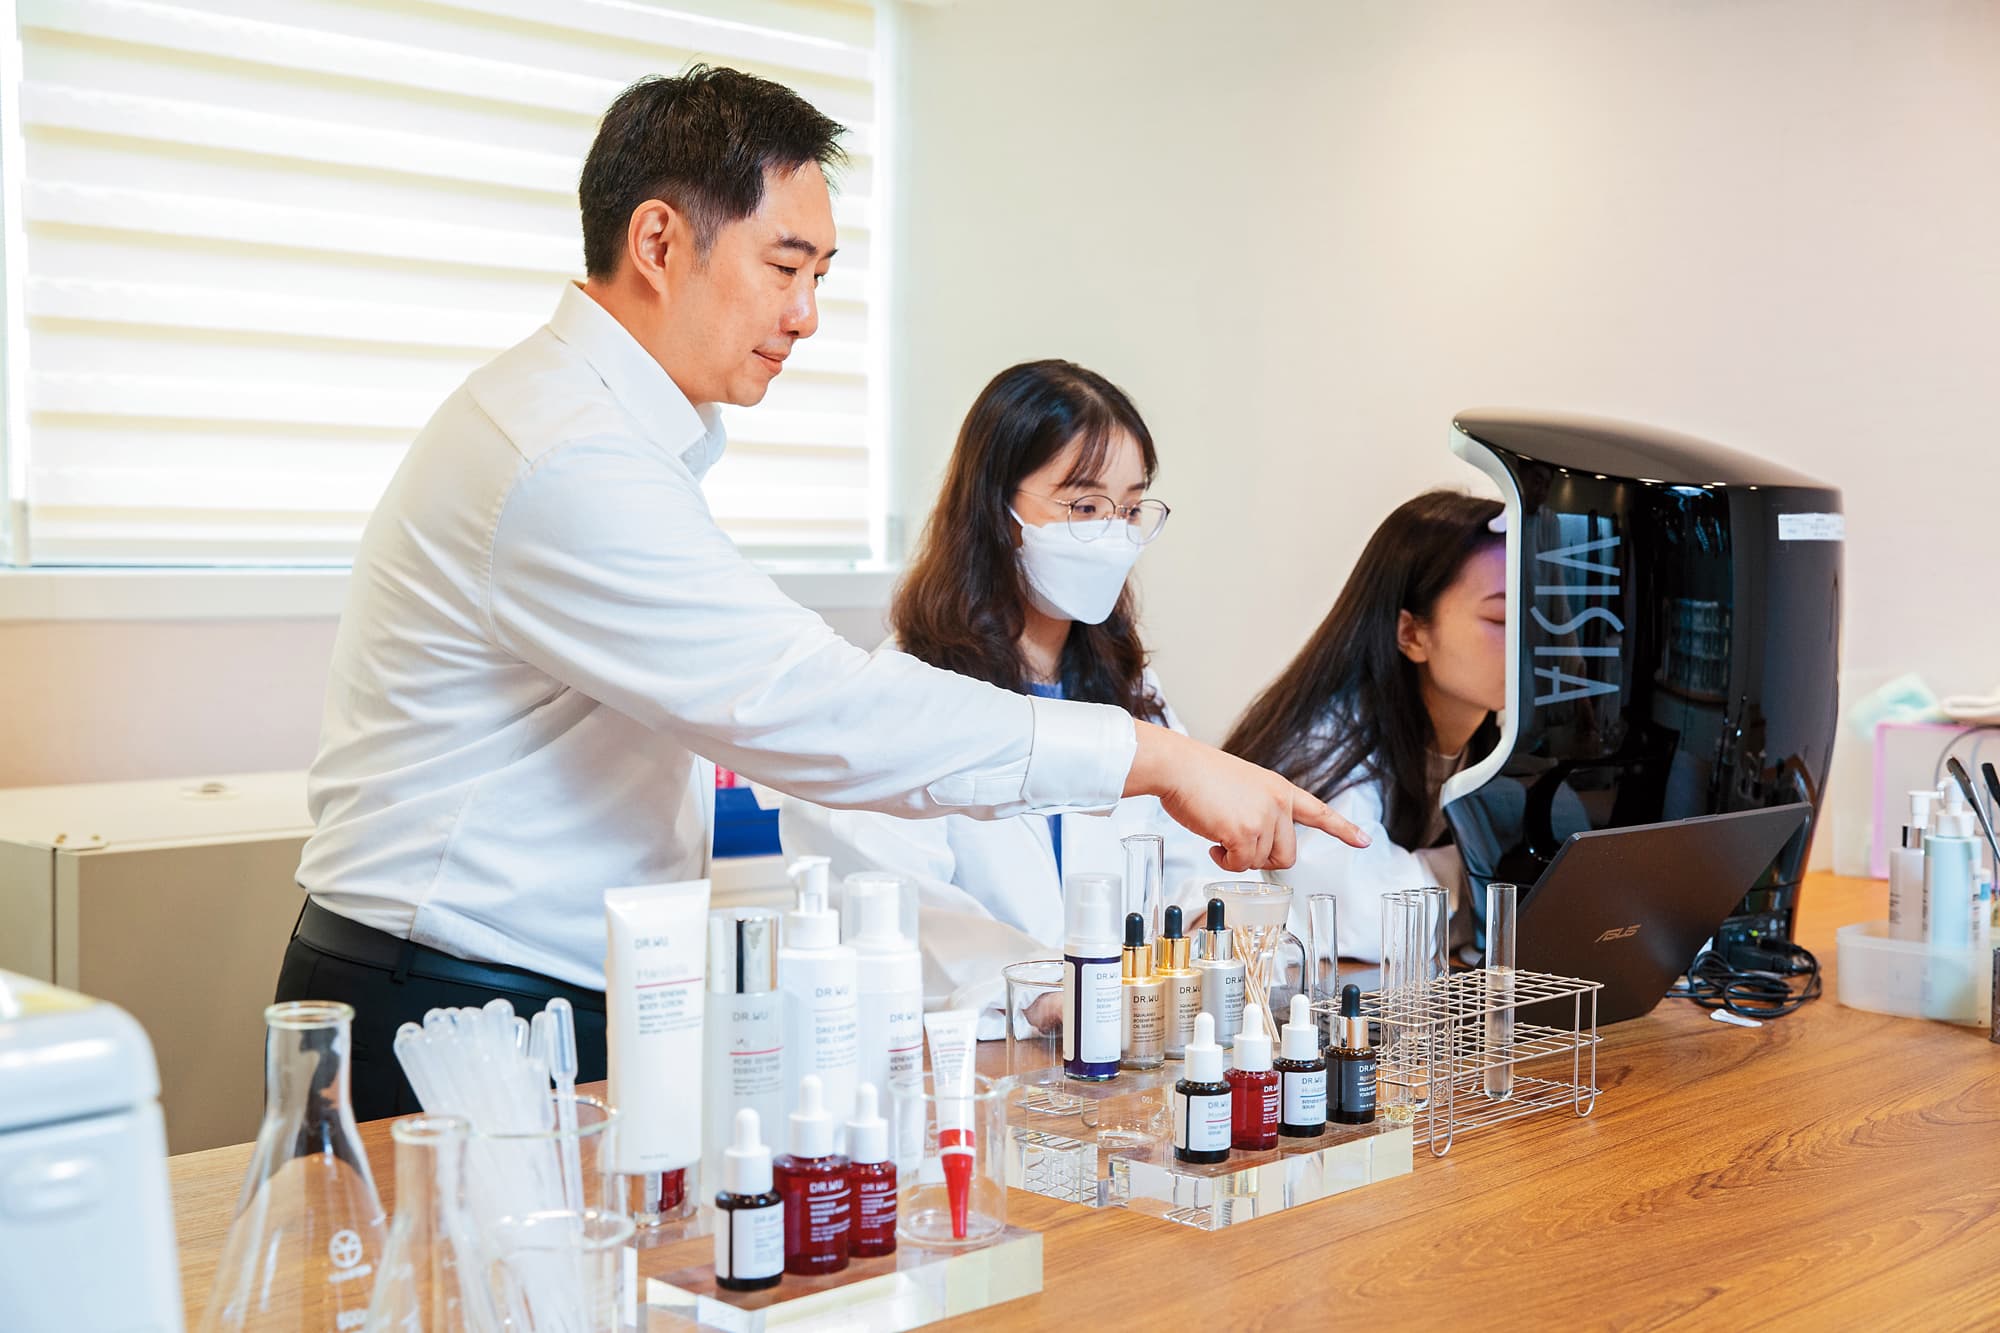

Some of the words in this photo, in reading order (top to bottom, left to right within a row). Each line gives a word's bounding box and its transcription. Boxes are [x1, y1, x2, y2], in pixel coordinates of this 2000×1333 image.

[1530, 536, 1624, 705] VISIA
[1594, 923, 1642, 943] ASUS
[1133, 995, 1159, 1004] DR.WU
[809, 1179, 844, 1193] DR.WU
